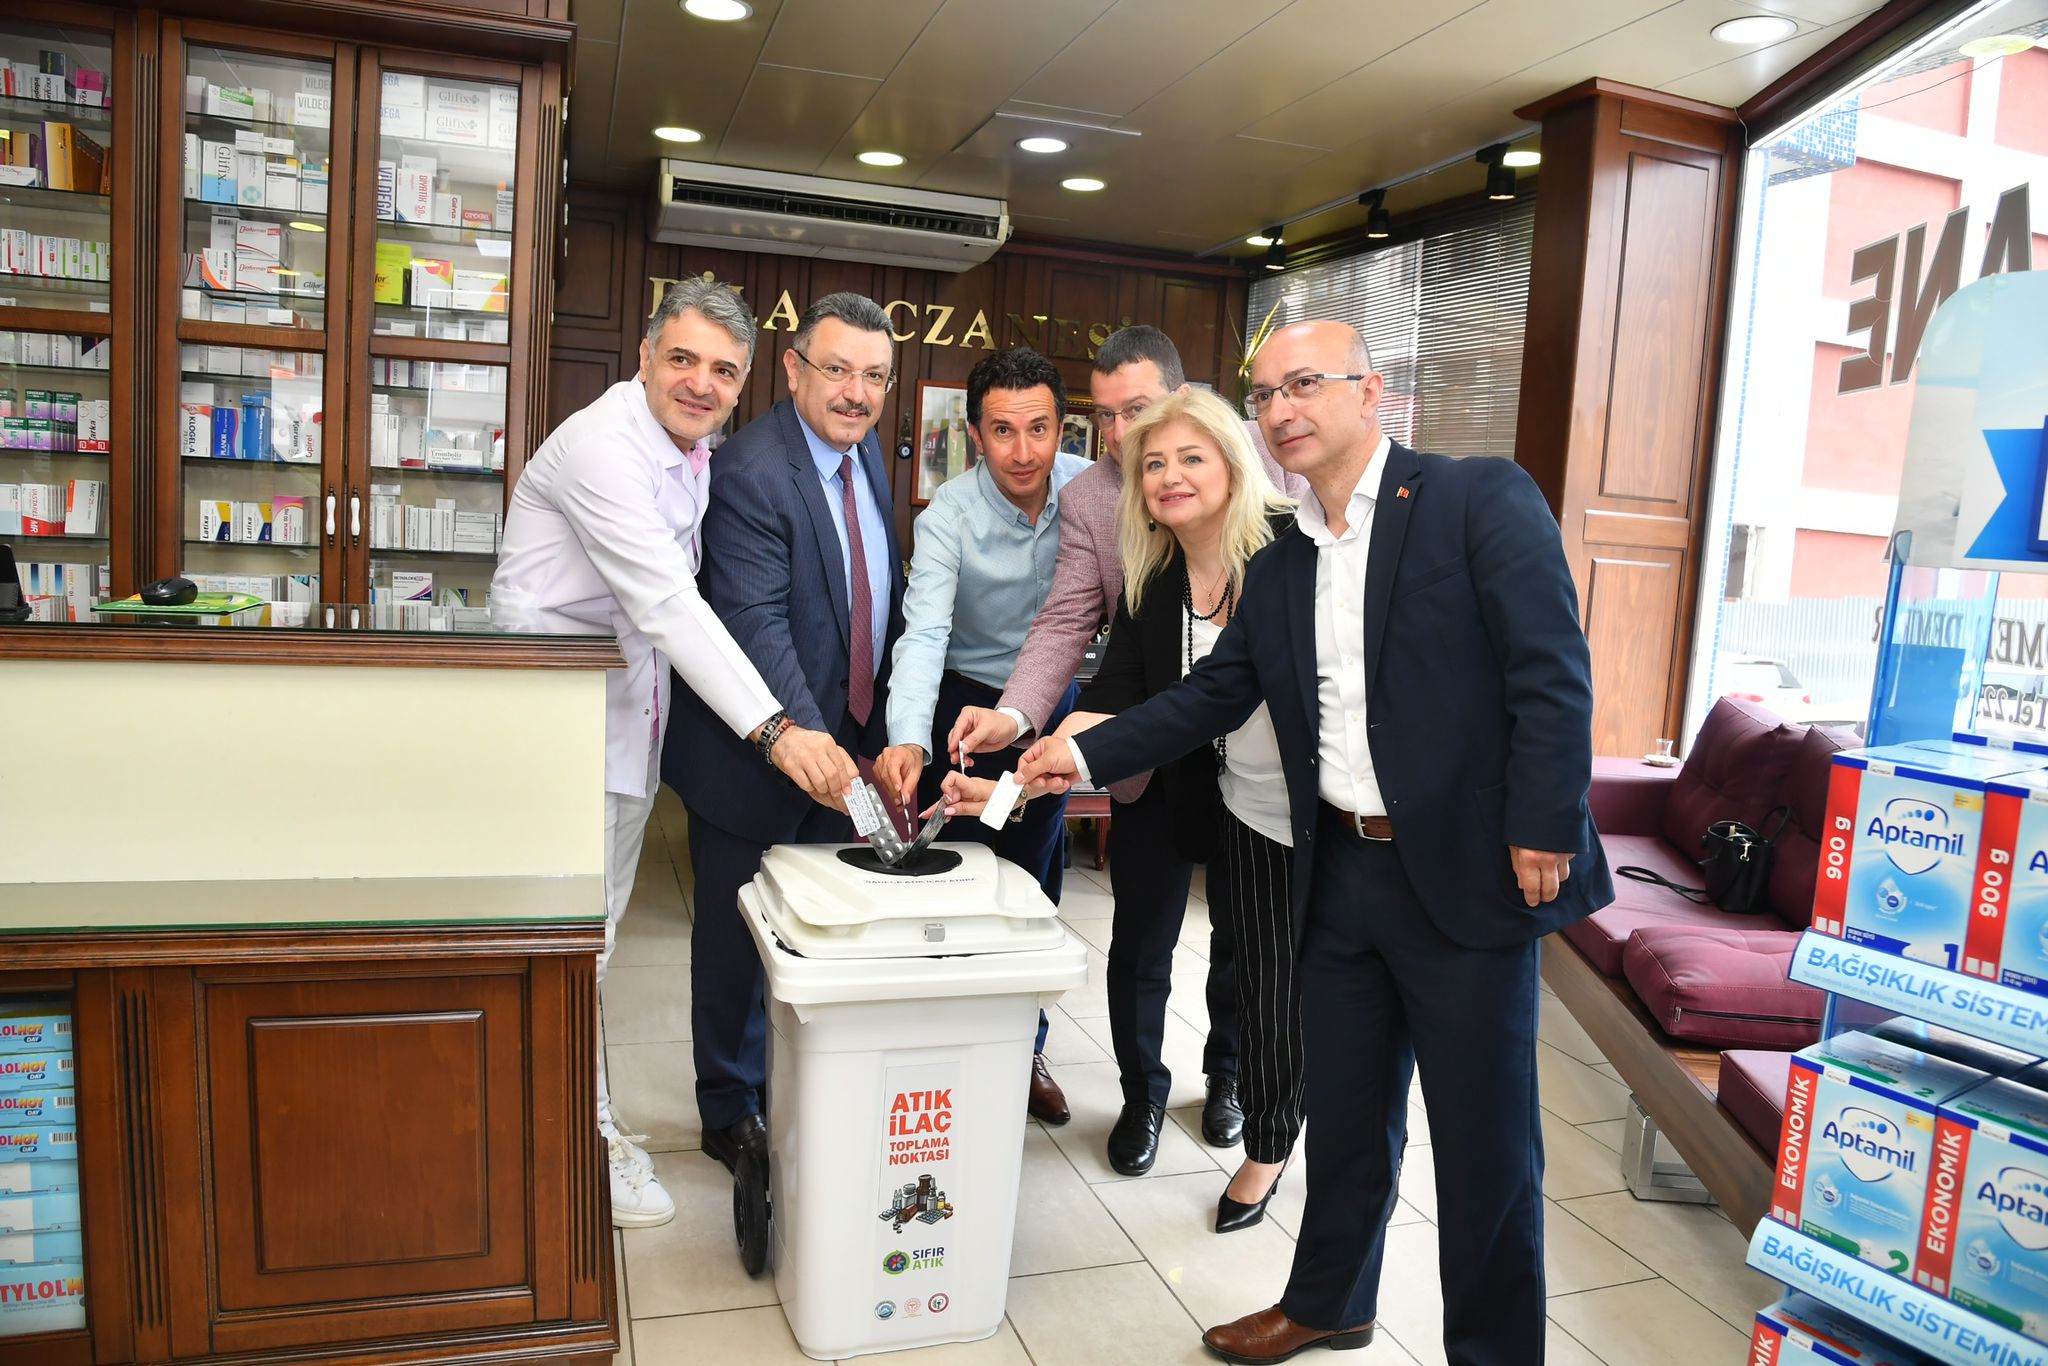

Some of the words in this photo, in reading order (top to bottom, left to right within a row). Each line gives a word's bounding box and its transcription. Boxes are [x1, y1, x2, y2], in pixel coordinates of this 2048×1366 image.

[30, 520, 39, 534] MR
[1835, 816, 1851, 831] g
[1867, 817, 1964, 856] Aptamil
[1825, 836, 1846, 880] 900
[1990, 848, 2010, 865] g
[1978, 871, 2003, 918] 900
[1944, 943, 1959, 971] 1
[1806, 947, 1950, 1004] BAĞIŞIKLIK
[0, 1024, 43, 1037] OLHOT
[890, 1088, 952, 1113] ATIK
[889, 1111, 952, 1136] İLAÇ
[1781, 1074, 1811, 1190] EKONOMİK
[889, 1137, 949, 1152] TOPLAMA
[889, 1149, 949, 1165] NOKTASI
[1822, 1121, 1916, 1173] Aptamil
[1926, 1129, 1963, 1255] EKONOMİK
[1977, 1181, 2048, 1226] Apta
[912, 1247, 945, 1260] SIFIR
[912, 1256, 944, 1271] ATIK
[1761, 1236, 1899, 1313] BAĞIŞIKLIK
